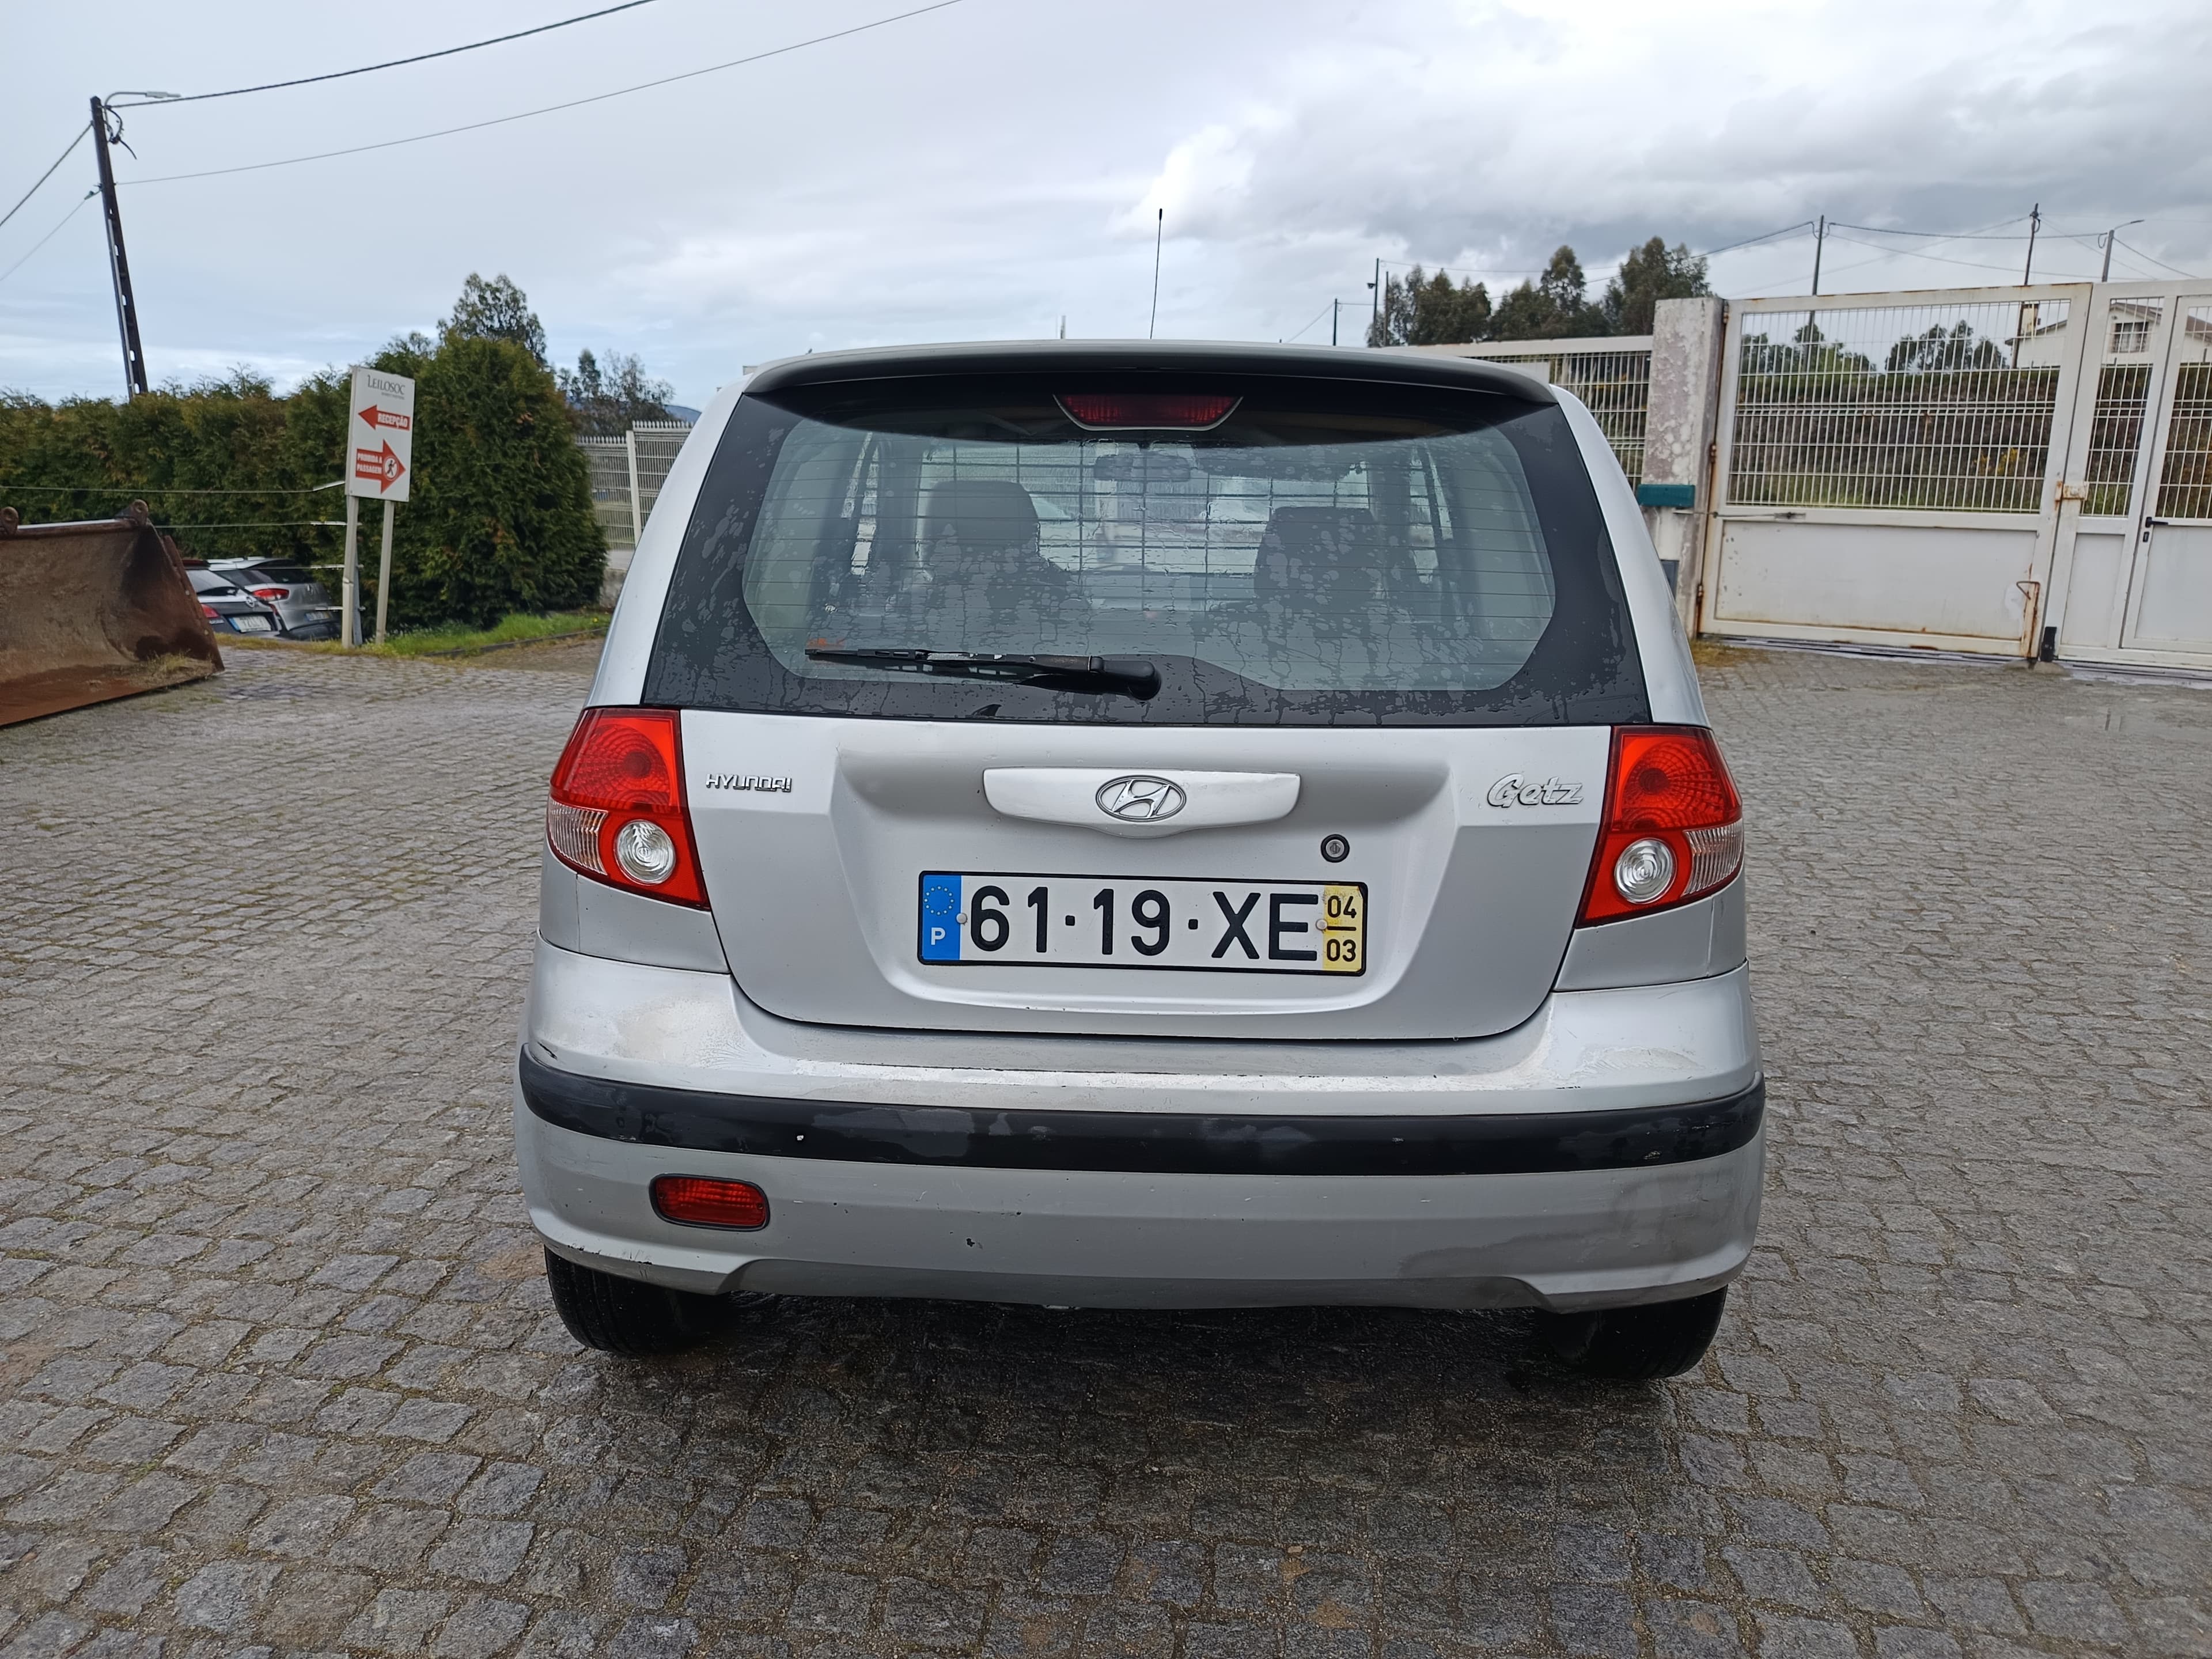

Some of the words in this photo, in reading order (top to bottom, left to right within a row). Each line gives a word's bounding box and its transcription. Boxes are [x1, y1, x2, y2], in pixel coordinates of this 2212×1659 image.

[368, 374, 406, 395] LEILOSOC
[377, 412, 408, 429] RECEPÇÃO
[706, 774, 792, 793] HYUNDAI
[1487, 772, 1583, 808] Getz
[1327, 895, 1357, 918] 04
[931, 927, 946, 945] P
[1327, 938, 1357, 962] 03
